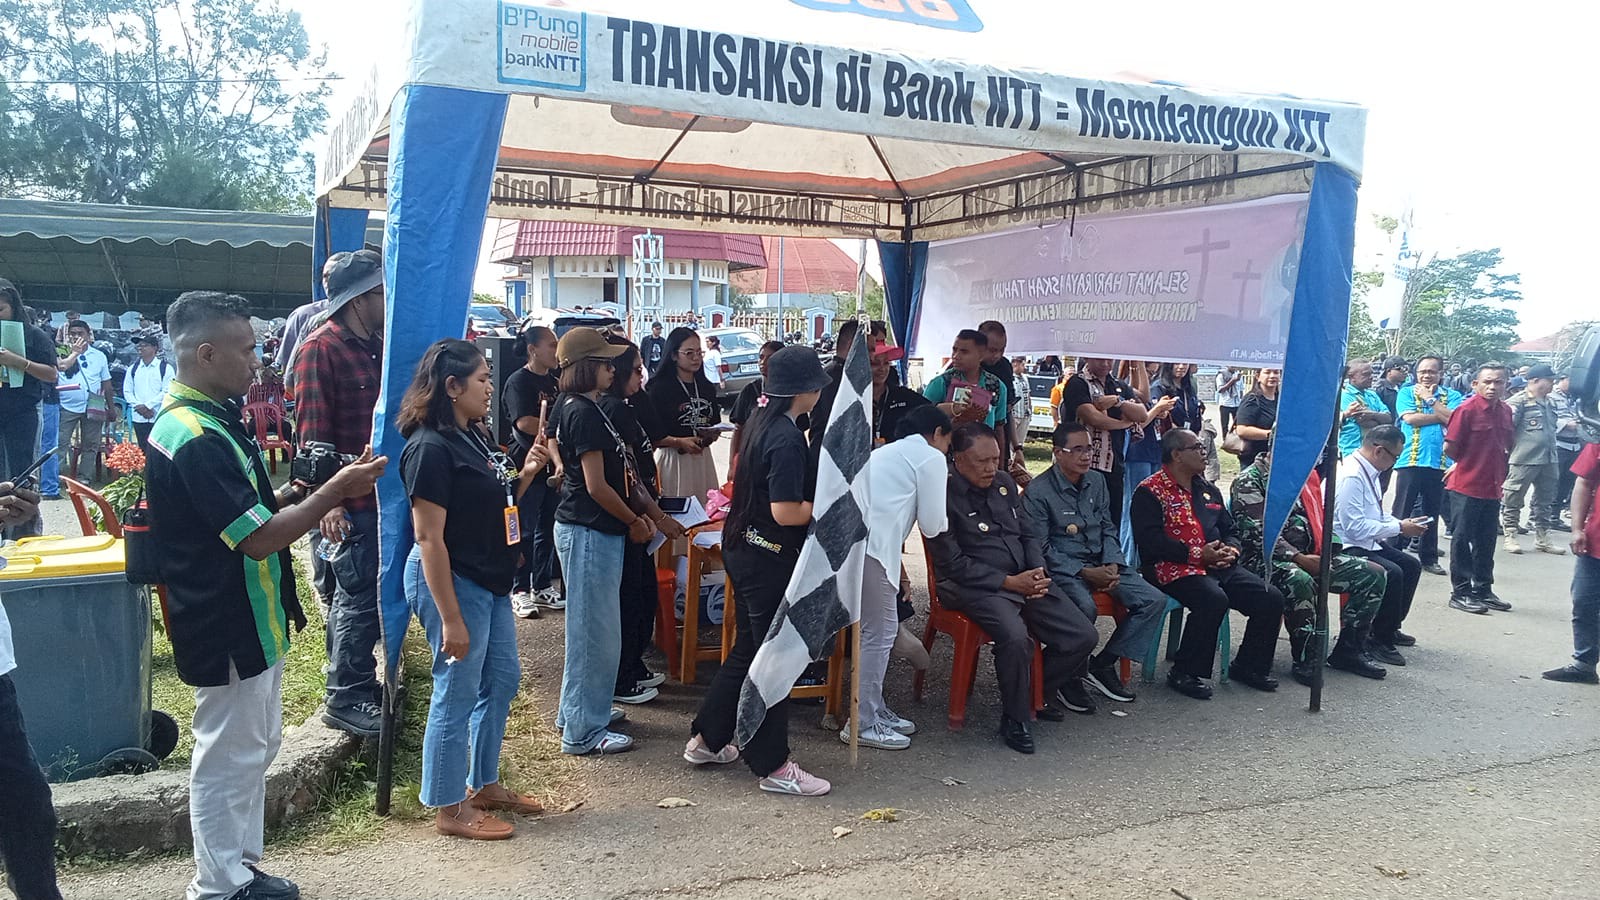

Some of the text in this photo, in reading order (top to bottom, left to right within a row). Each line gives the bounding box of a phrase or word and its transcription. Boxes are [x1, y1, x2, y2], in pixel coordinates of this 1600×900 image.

[504, 6, 579, 39] B'Pung
[520, 34, 578, 53] mobile
[505, 48, 580, 72] bankNTT
[606, 16, 824, 108] TRANSAKSI
[836, 53, 872, 114] di
[883, 60, 975, 126] Bank
[985, 75, 1043, 131] NTT
[1075, 87, 1279, 151] Membangun
[1283, 107, 1331, 157] NTT
